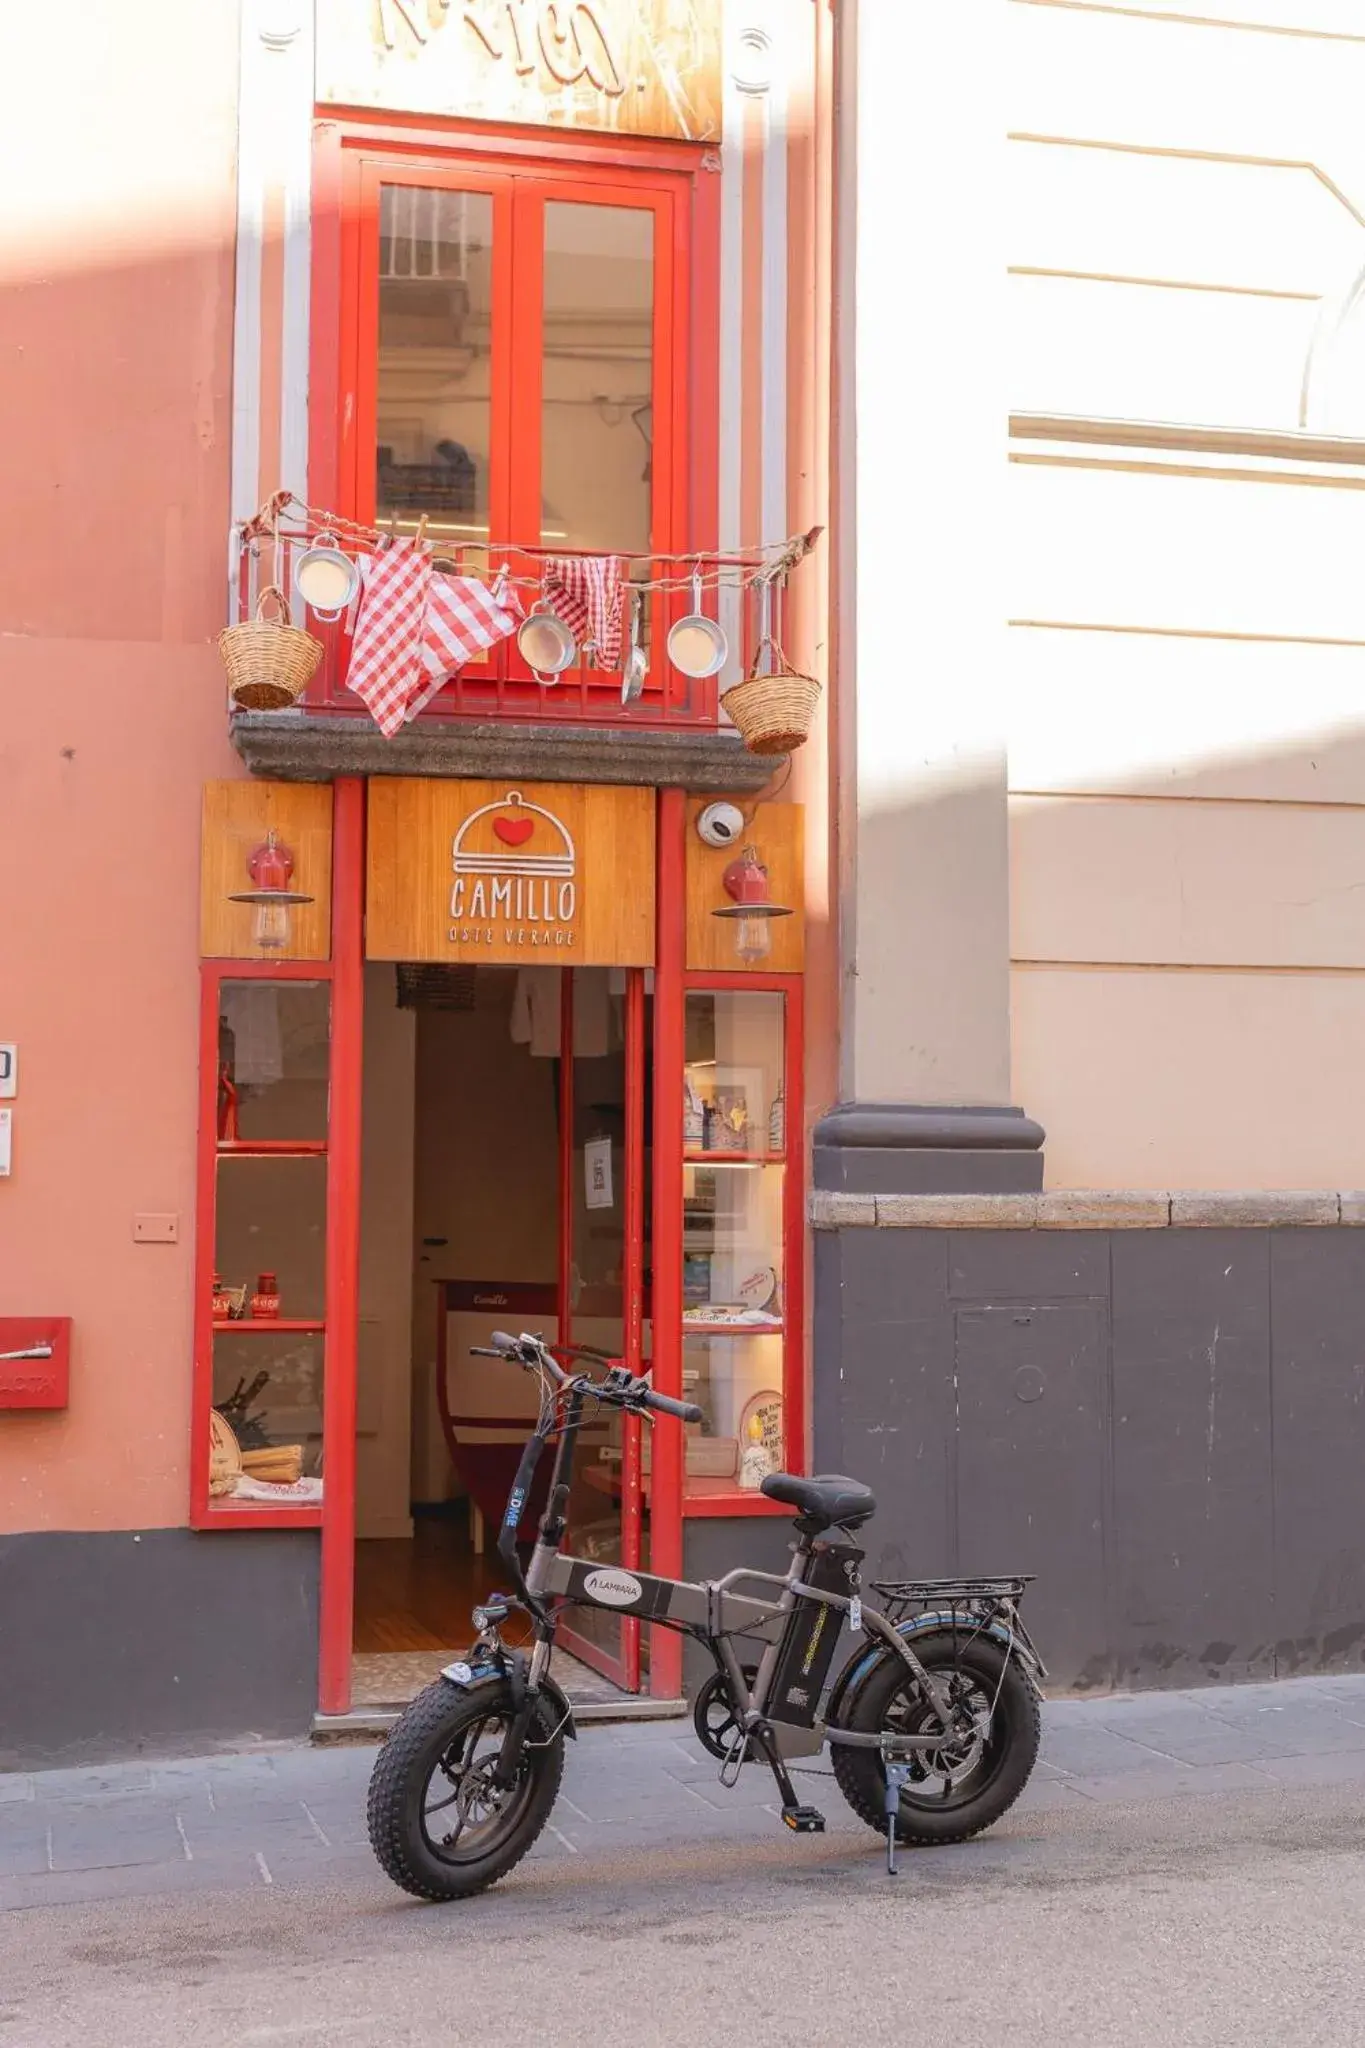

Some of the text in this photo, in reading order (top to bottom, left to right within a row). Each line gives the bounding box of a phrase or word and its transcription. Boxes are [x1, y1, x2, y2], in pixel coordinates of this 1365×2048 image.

[451, 877, 575, 921] CAMILLO
[449, 926, 493, 943] OSTE
[599, 1580, 637, 1595] LAMPARA
